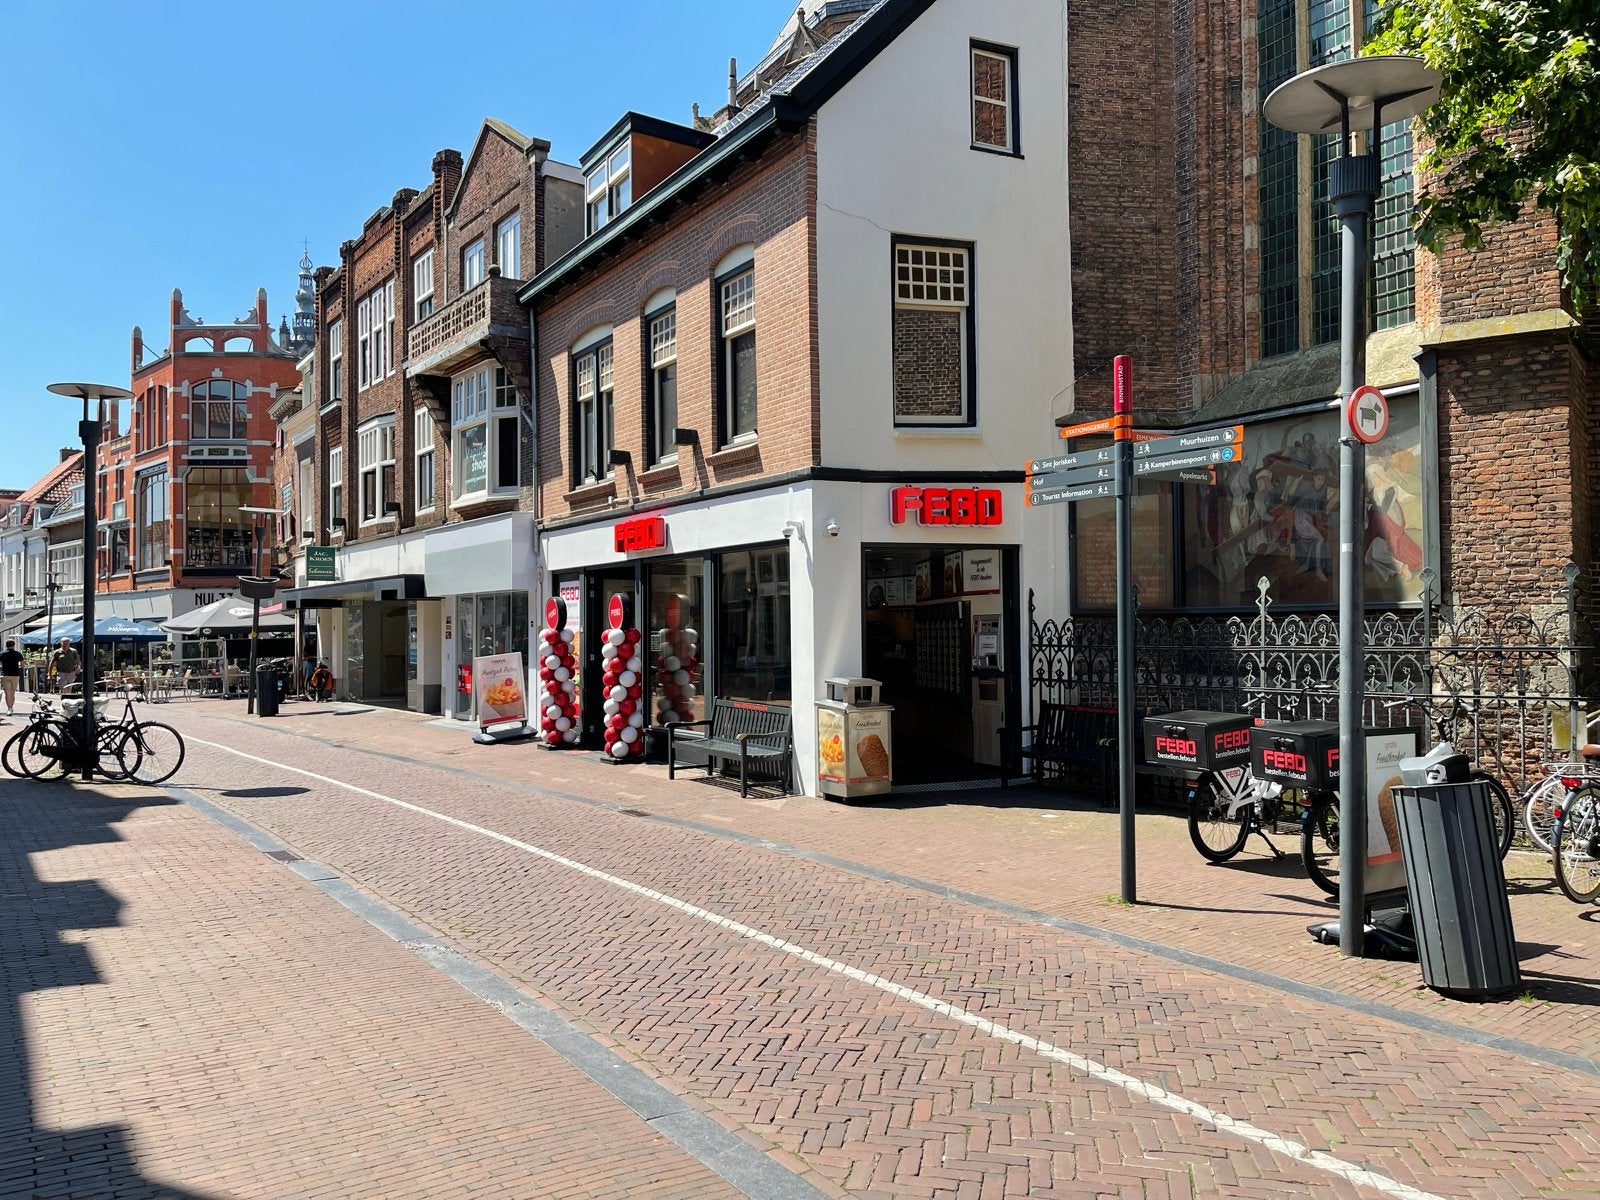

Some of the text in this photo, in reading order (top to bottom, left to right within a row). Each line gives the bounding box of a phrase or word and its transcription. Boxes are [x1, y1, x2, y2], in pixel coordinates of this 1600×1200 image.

[1065, 421, 1110, 436] STATIONSGEBIED
[1180, 434, 1220, 446] Muurhuizen
[471, 460, 487, 473] shop
[1042, 456, 1077, 469] Sint Joriskerk
[1150, 455, 1207, 469] Kamperbinnenpoort
[1033, 478, 1044, 486] Hof
[1179, 471, 1208, 480] Appelmarkt
[1042, 488, 1093, 501] Tourist Information
[891, 487, 1003, 525] FEBO
[614, 517, 665, 553] FEBO
[561, 586, 580, 601] FEBO
[1156, 736, 1197, 756] FEBO
[1214, 728, 1251, 751] FEBO
[1157, 752, 1198, 763] bestellen.febo.nl
[1215, 745, 1251, 759] bestellen.febo.nl
[1263, 749, 1307, 773] FEBO
[1225, 769, 1242, 779] FEBO
[1264, 767, 1307, 781] bestellen.febo.nl
